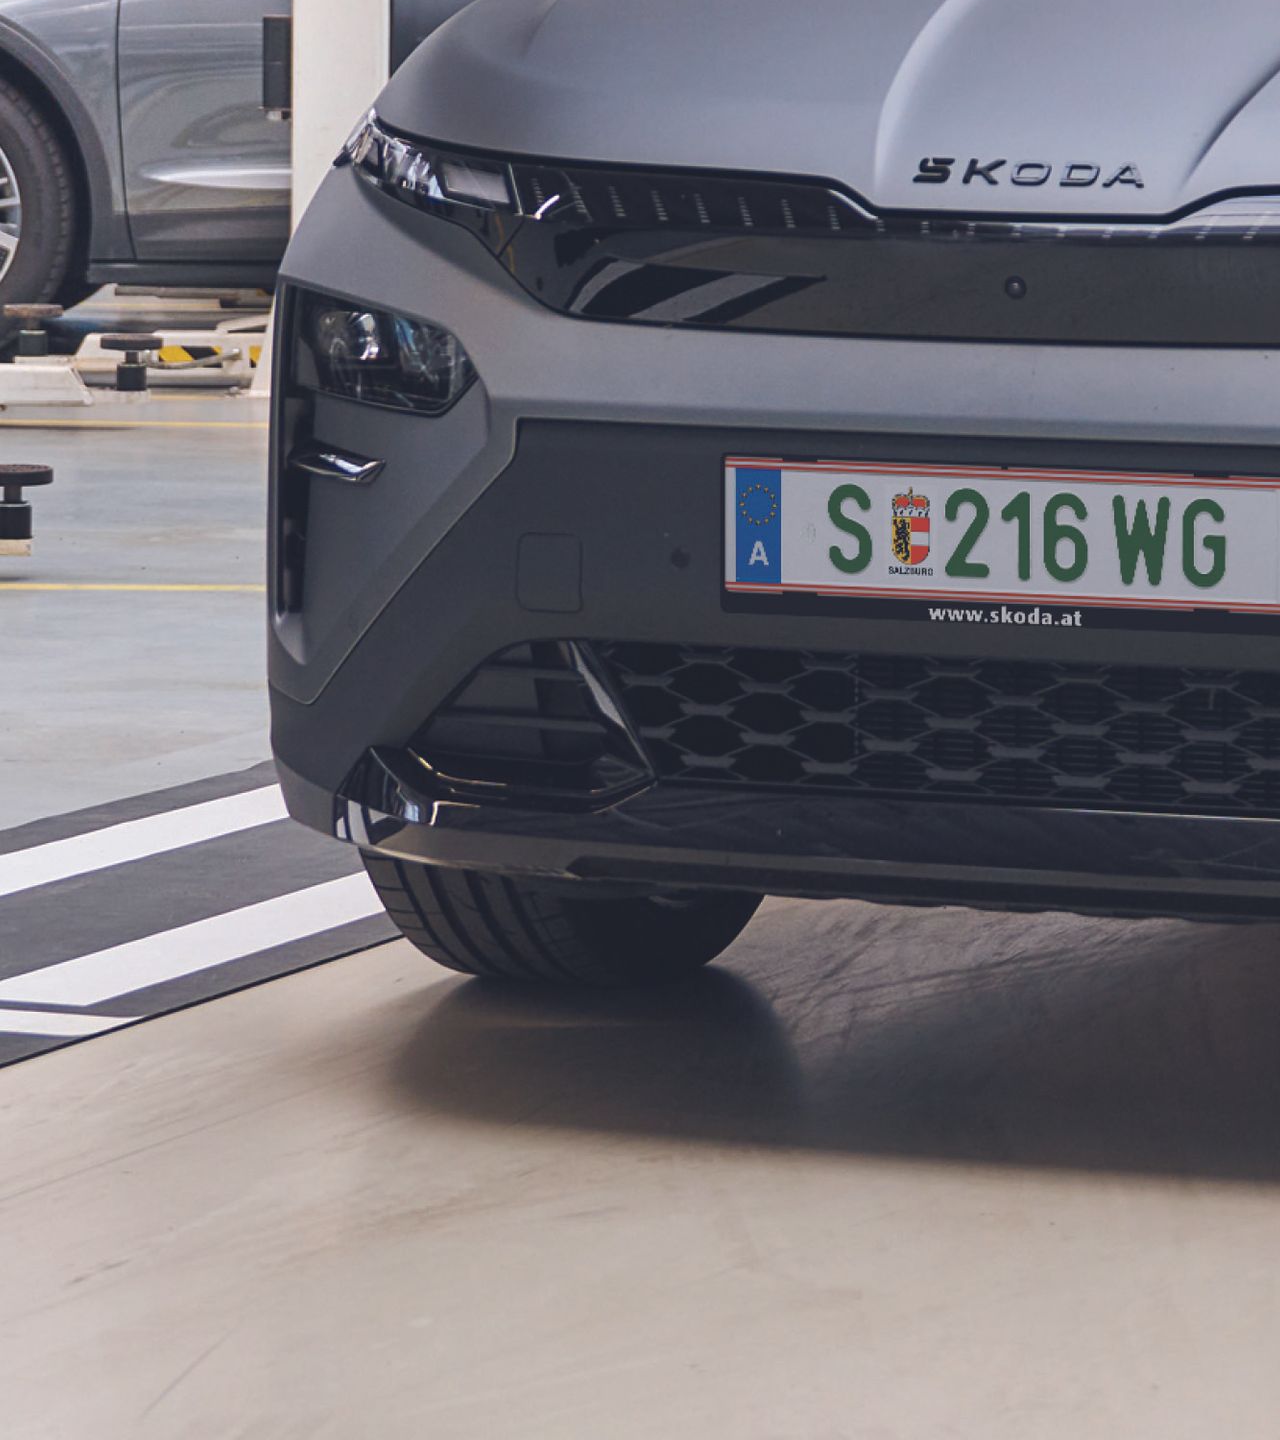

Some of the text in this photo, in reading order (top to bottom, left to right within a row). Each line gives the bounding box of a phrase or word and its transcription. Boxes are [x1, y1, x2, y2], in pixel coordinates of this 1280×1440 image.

[827, 484, 1227, 588] S 216 WG
[749, 541, 769, 566] A
[928, 606, 1083, 628] www.skoda.at
